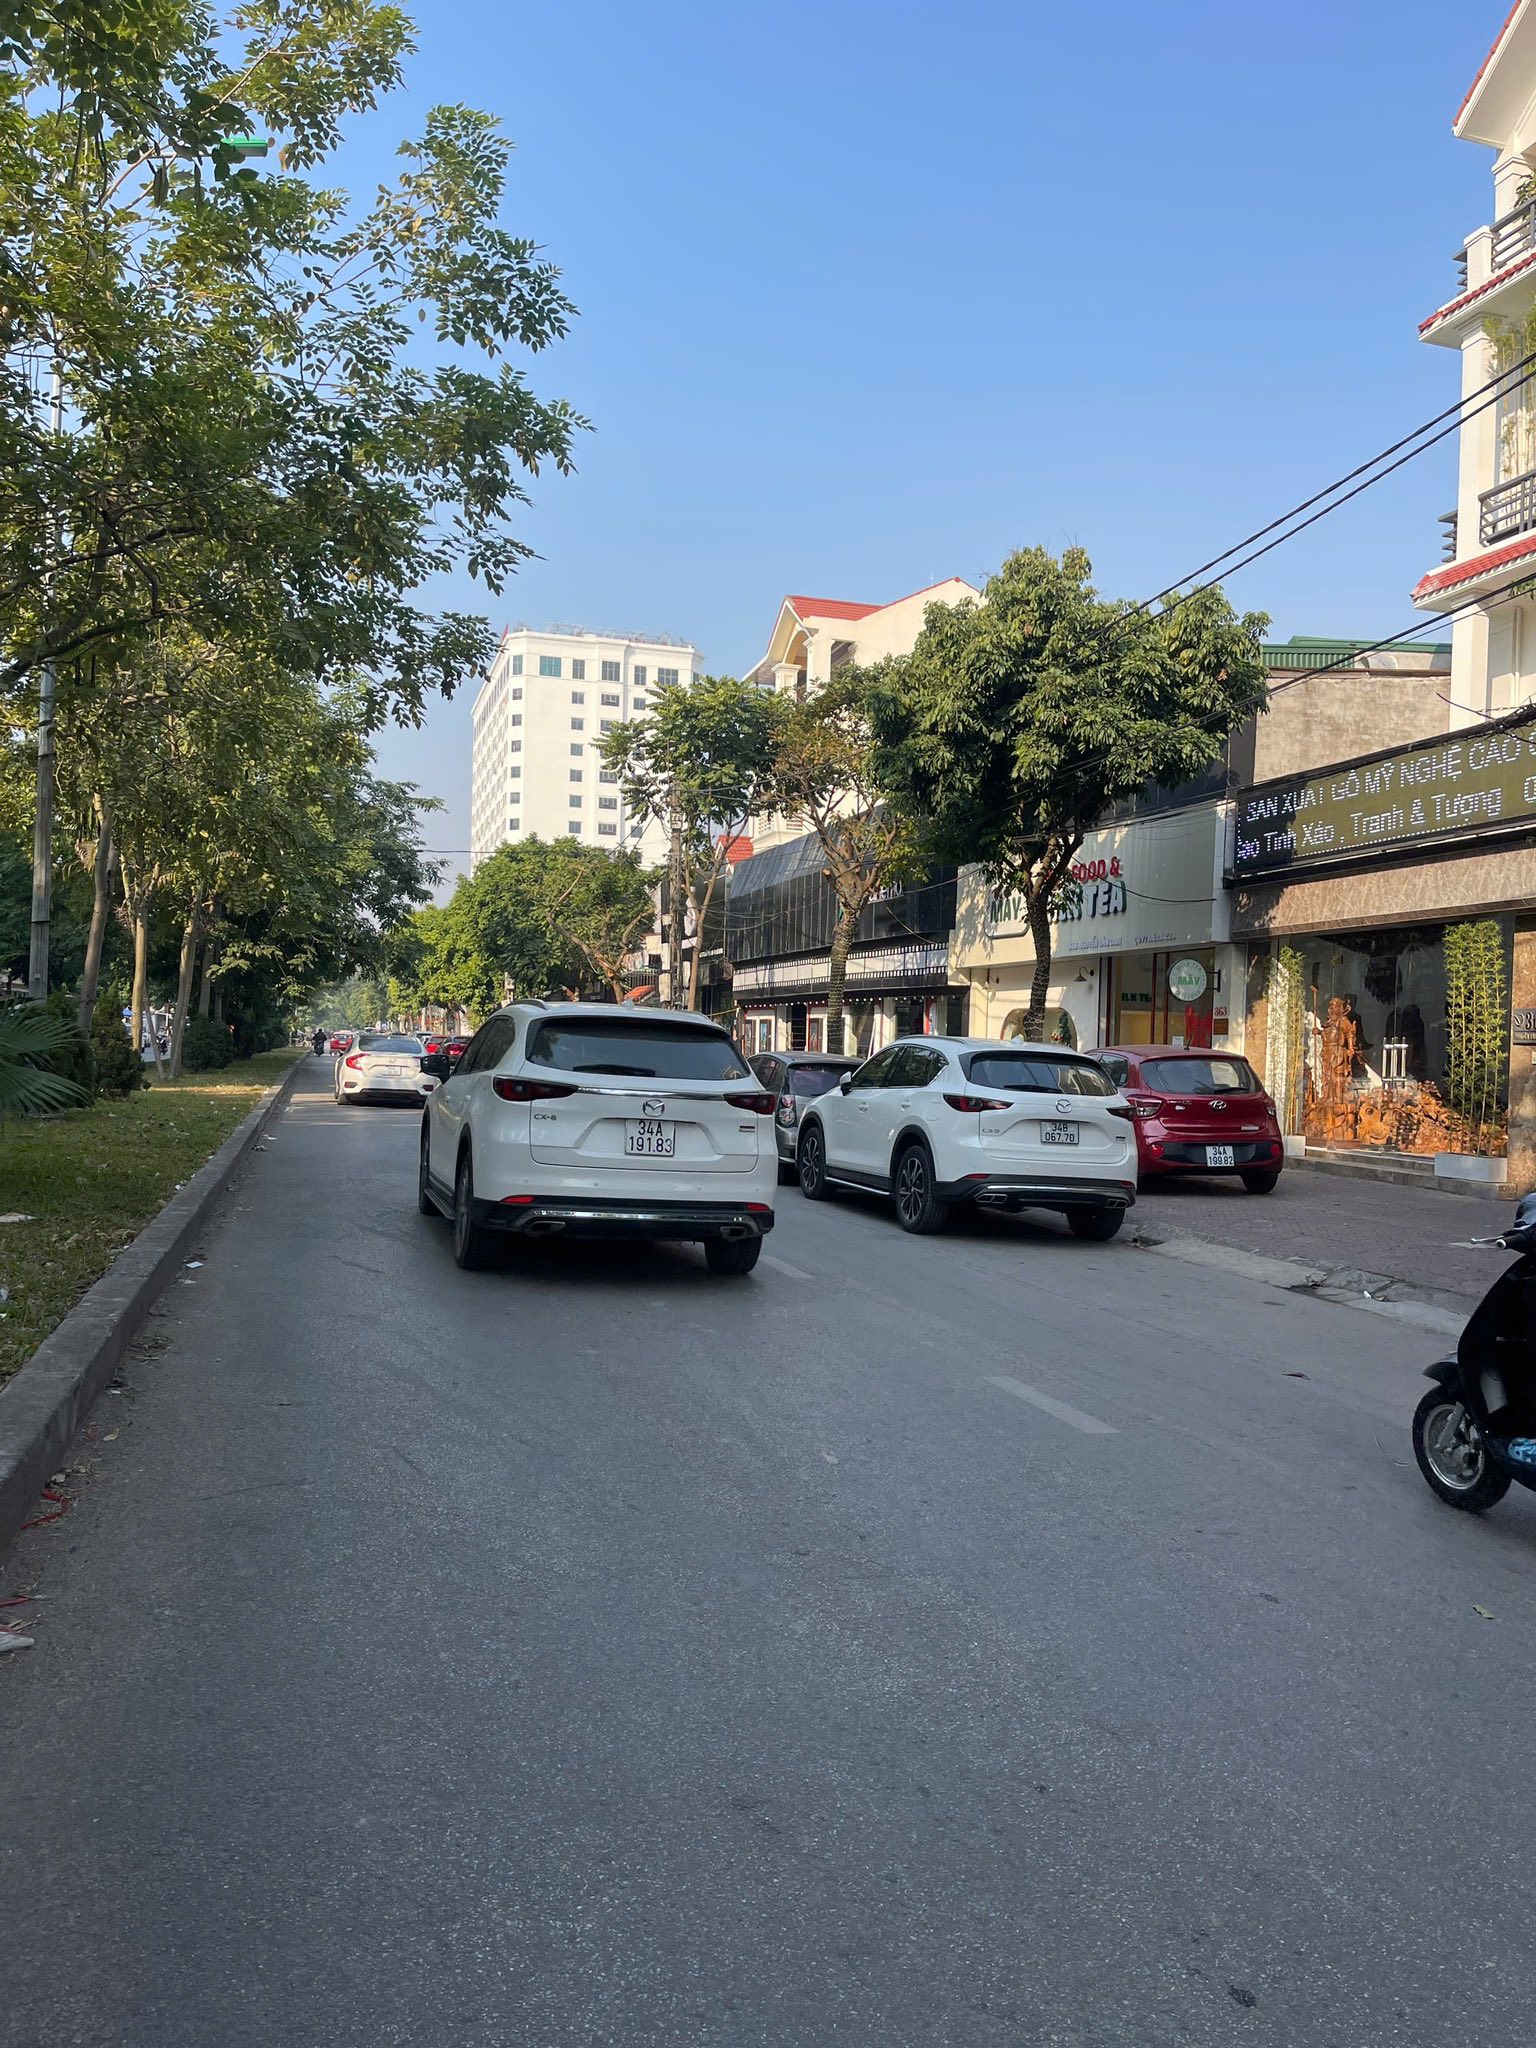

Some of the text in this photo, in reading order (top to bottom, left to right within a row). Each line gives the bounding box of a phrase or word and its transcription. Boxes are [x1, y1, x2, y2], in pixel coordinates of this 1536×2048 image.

[1350, 804, 1404, 838] Tranh
[1085, 880, 1127, 918] TEA
[638, 1121, 664, 1138] 34A
[1051, 1122, 1068, 1133] 34B
[629, 1136, 673, 1153] 191.83
[1044, 1132, 1076, 1143] 067.70
[1212, 1147, 1228, 1156] 34A
